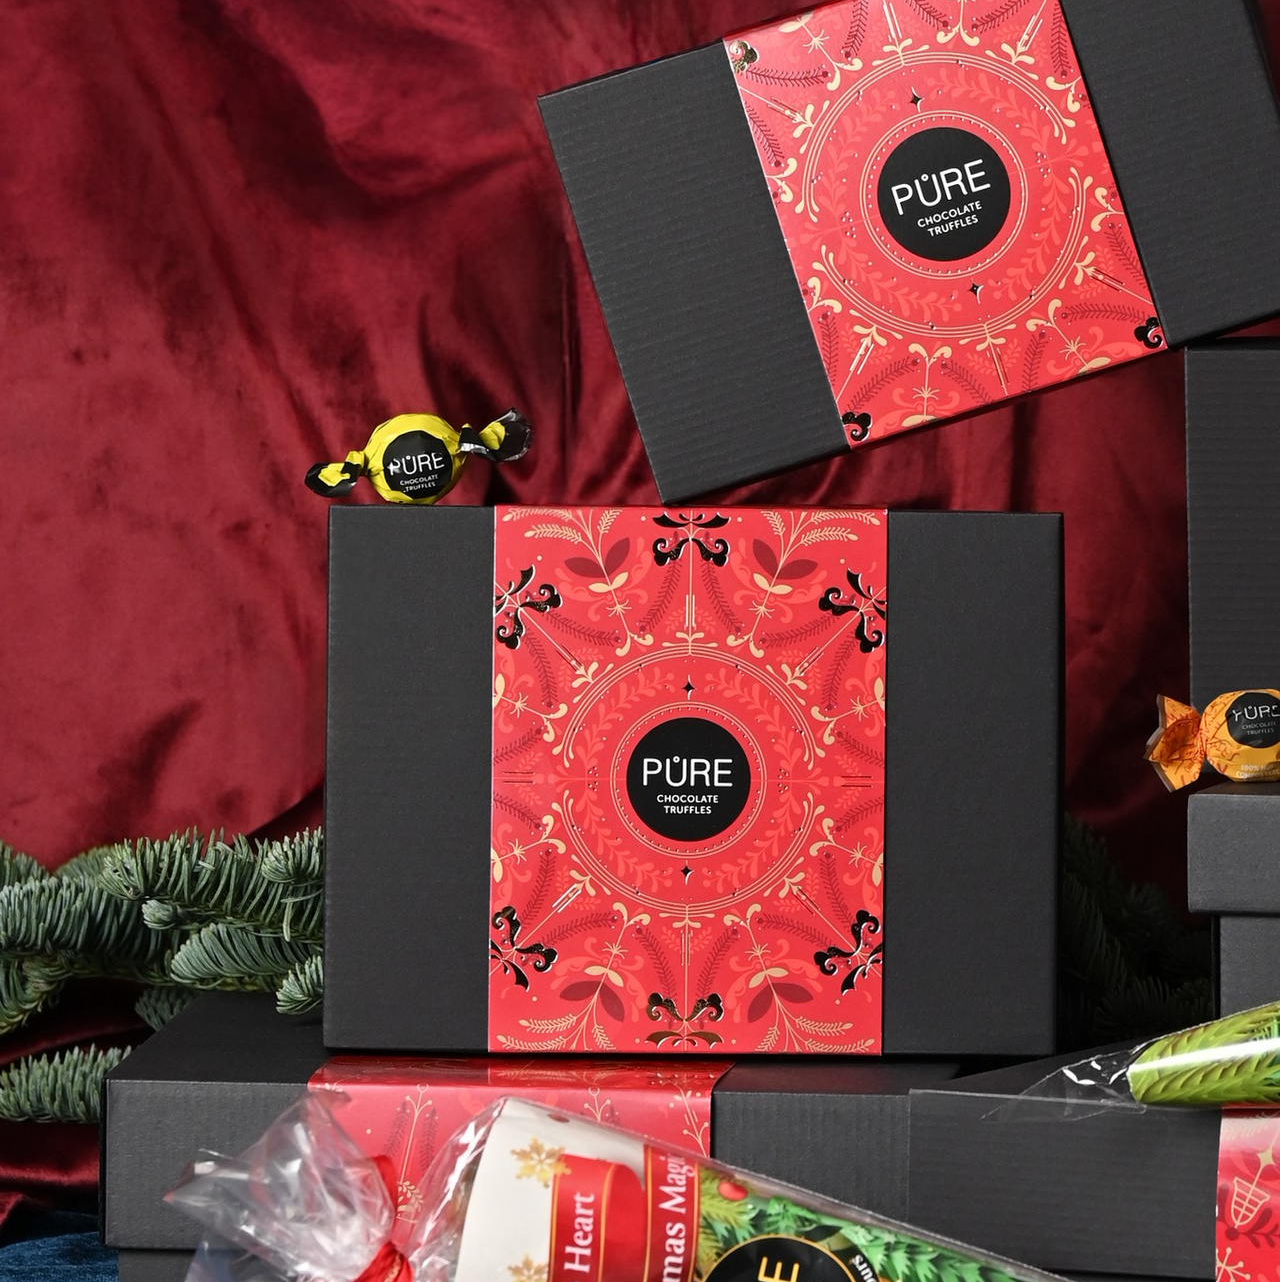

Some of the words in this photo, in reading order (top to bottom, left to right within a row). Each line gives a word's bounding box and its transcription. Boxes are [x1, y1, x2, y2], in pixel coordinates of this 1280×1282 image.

[917, 200, 983, 228] CHOCOLATE
[927, 213, 979, 237] TRUFFLES
[399, 474, 439, 486] CHOCOLATE
[404, 481, 436, 493] TRUFFLES
[1241, 721, 1276, 730] CHOCOLATE
[1247, 728, 1275, 736] TRUFFLES
[656, 794, 719, 804] CHOCOLATE
[663, 805, 712, 815] TRUFFLES
[658, 1154, 695, 1215] Magi
[564, 1192, 595, 1273] Heart
